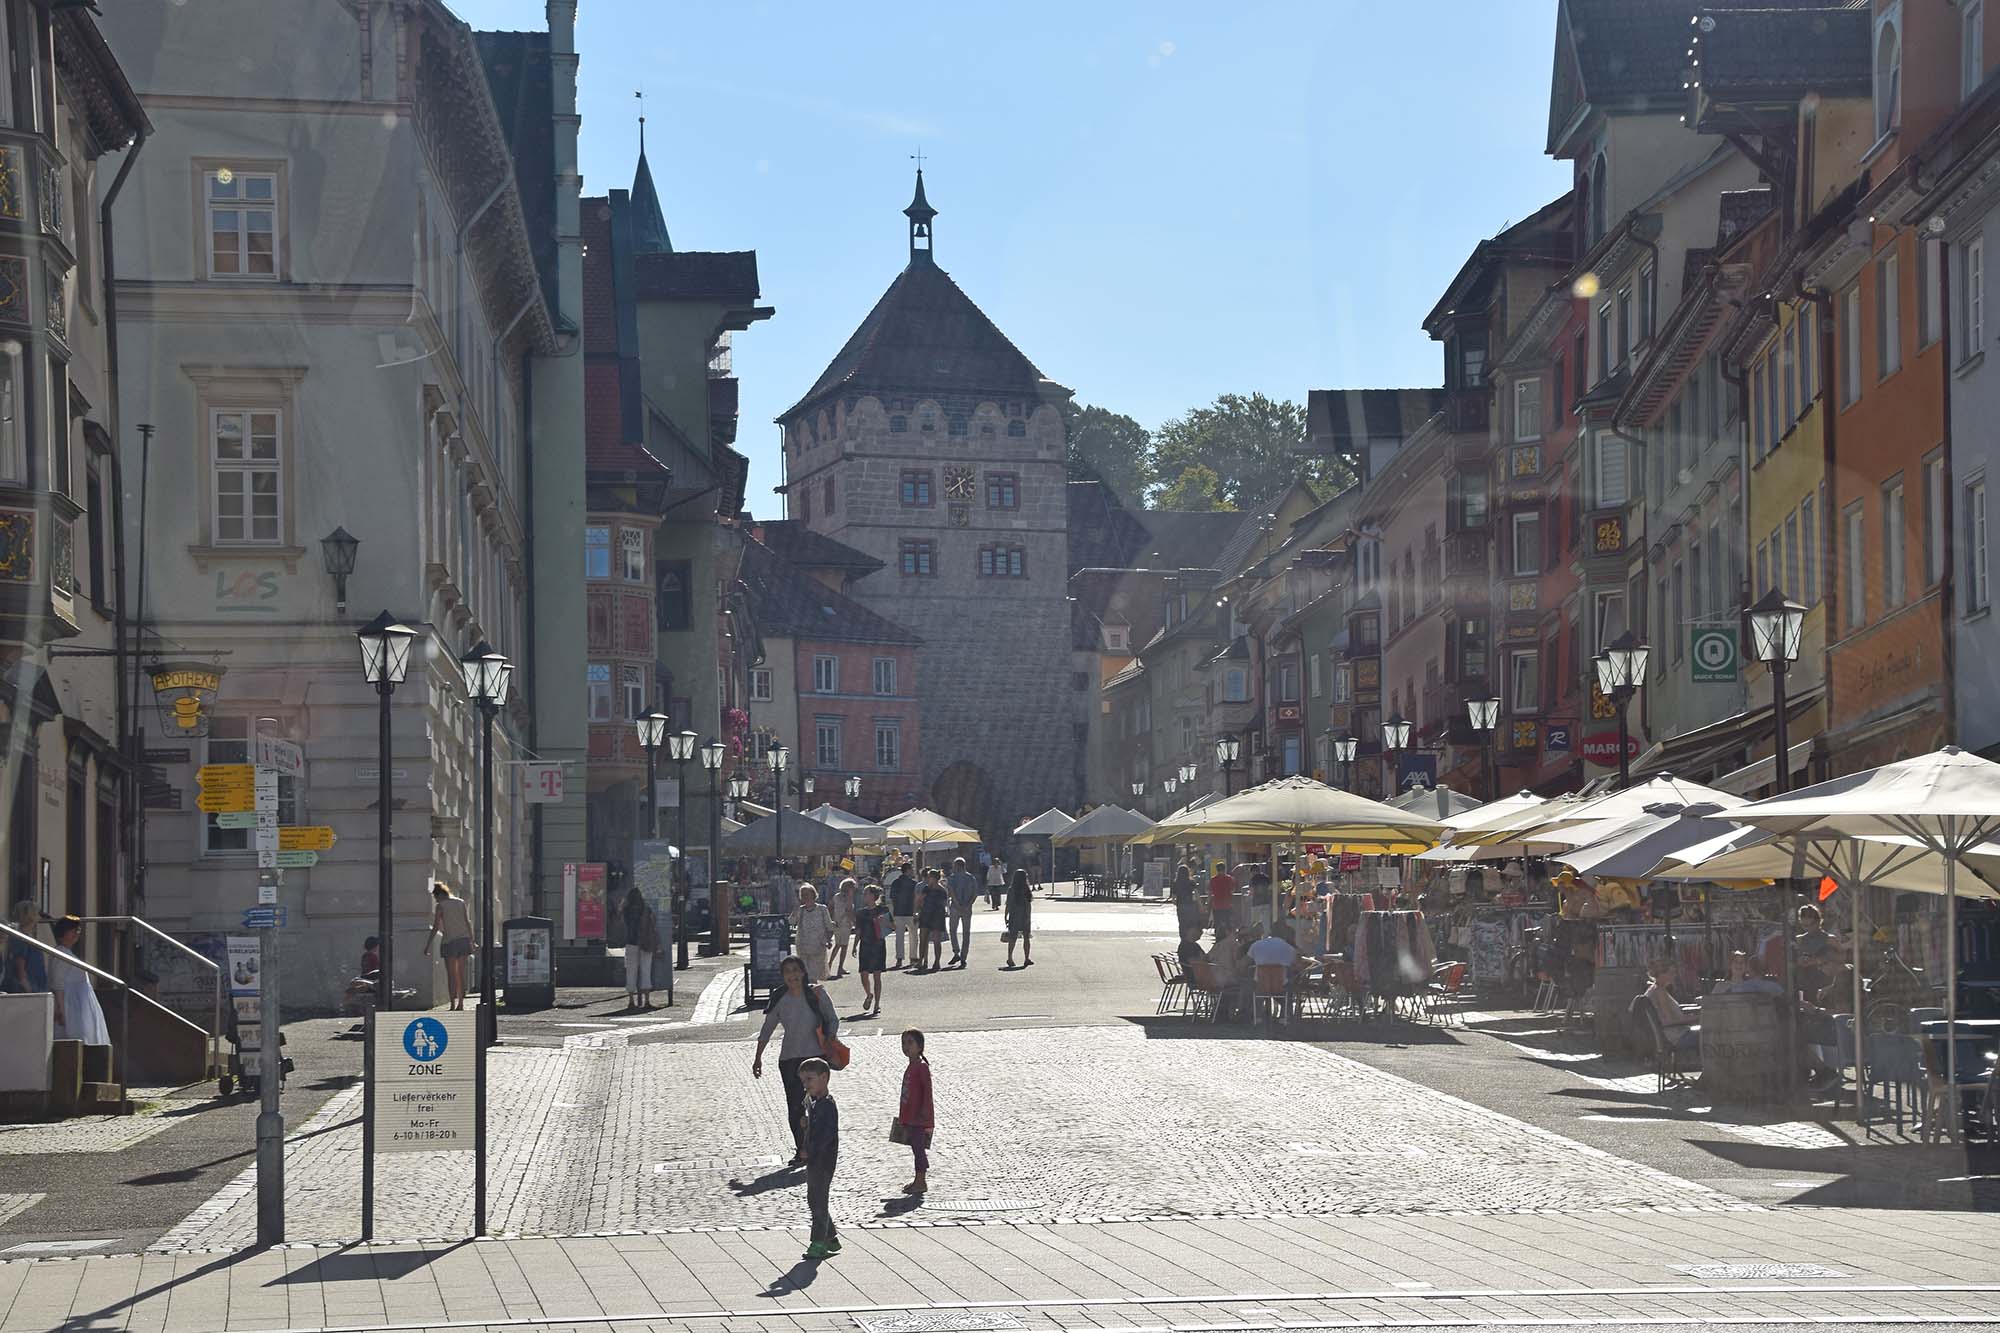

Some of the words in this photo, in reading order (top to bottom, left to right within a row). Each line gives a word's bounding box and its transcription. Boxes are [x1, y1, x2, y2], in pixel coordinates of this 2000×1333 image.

[155, 671, 217, 689] APOTHEKE
[1401, 771, 1431, 786] AXA
[408, 1064, 443, 1076] ZONE
[393, 1092, 457, 1103] Lieferverkehr
[417, 1104, 434, 1112] frei
[410, 1119, 440, 1128] Mo-Fr
